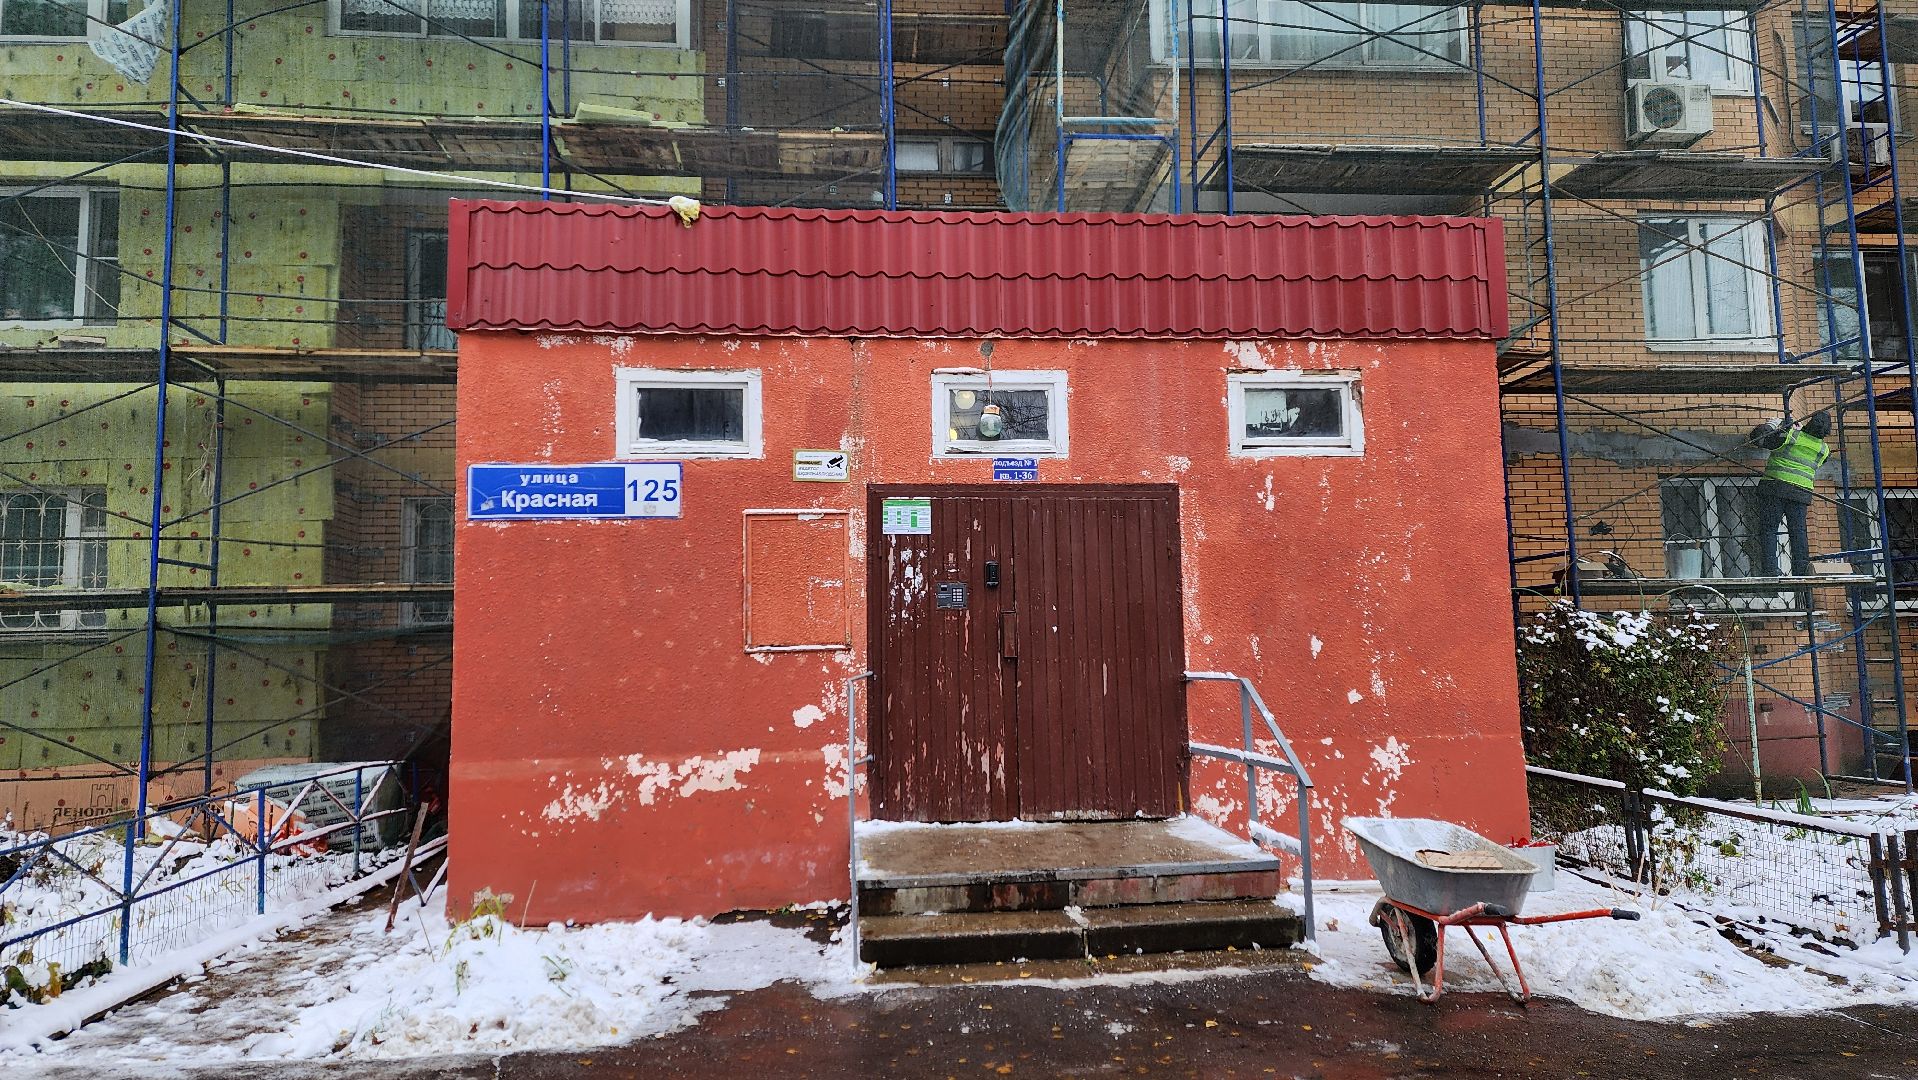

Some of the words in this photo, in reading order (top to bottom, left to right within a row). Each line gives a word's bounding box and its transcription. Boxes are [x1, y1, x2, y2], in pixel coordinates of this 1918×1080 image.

[520, 473, 579, 487] улица
[1014, 471, 1033, 480] 1-36
[627, 479, 678, 502] 125
[501, 489, 598, 512] Красная
